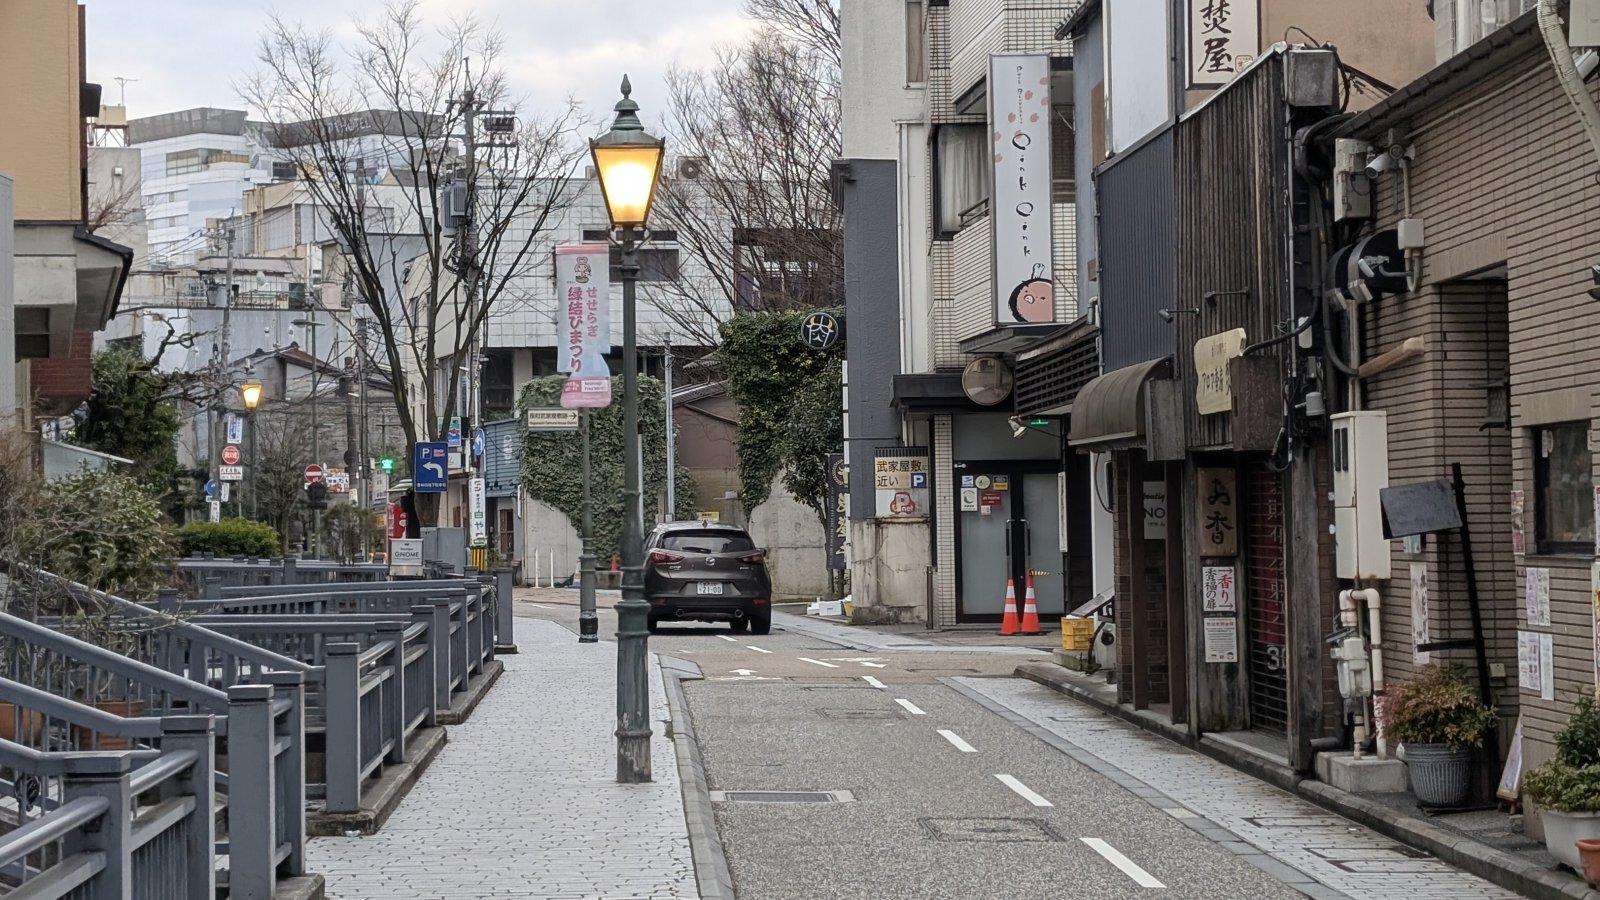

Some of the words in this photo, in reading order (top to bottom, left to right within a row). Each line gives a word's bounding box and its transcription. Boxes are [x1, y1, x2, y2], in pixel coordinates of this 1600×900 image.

[1012, 133, 1032, 191] Oink
[1015, 201, 1034, 257] Oink
[567, 286, 584, 373] 縁結びまつり
[586, 286, 599, 338] せせらぎ
[422, 447, 430, 459] P
[876, 460, 928, 472] 武家屋敷に
[877, 475, 899, 487] 近い
[913, 475, 924, 487] P
[1205, 479, 1233, 545] お香
[1217, 574, 1233, 604] 香り
